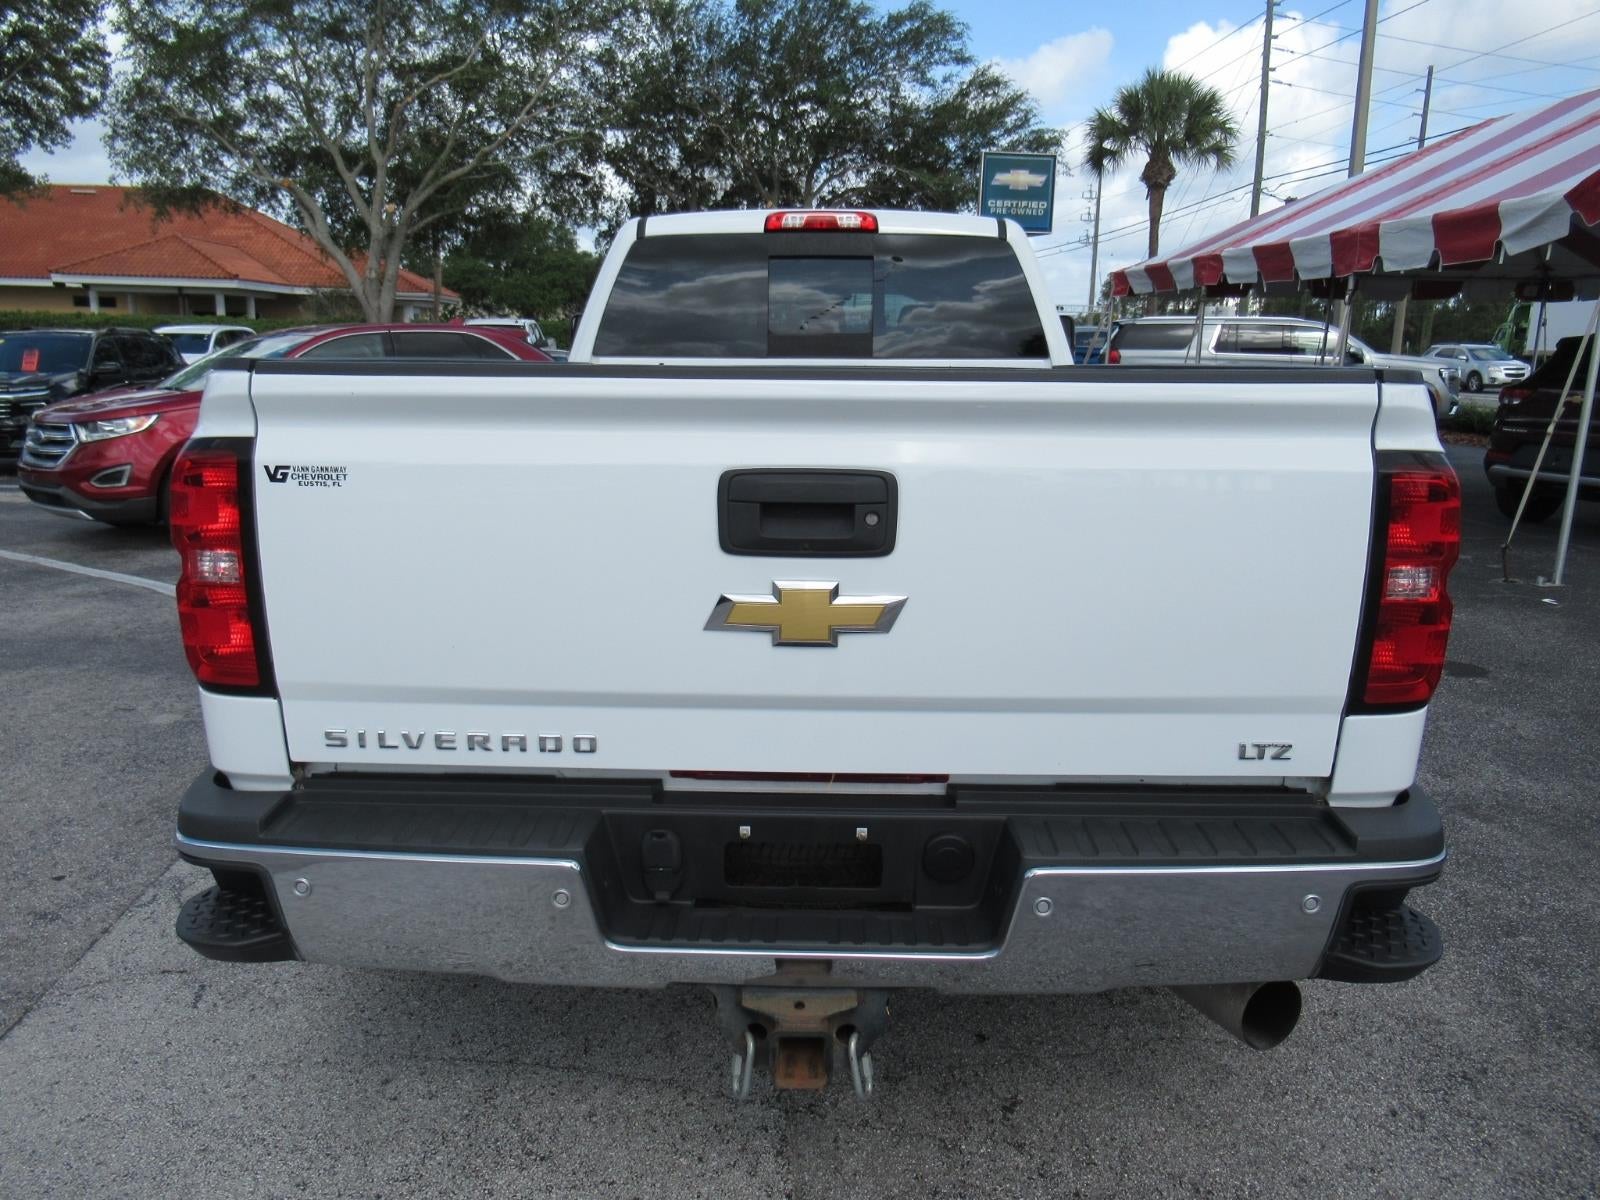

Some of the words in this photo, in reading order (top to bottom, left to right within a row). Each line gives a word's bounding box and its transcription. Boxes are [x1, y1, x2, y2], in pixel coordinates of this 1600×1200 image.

[987, 200, 1047, 209] CERTIFIED
[990, 207, 1044, 216] PRE-OWNED
[292, 465, 310, 473] VANN
[311, 465, 347, 474] GANNAWAY
[291, 473, 348, 481] CHEVROLET
[298, 480, 330, 488] EUSTIS,
[324, 728, 598, 754] SILVERADO
[1238, 743, 1293, 760] LTZ
